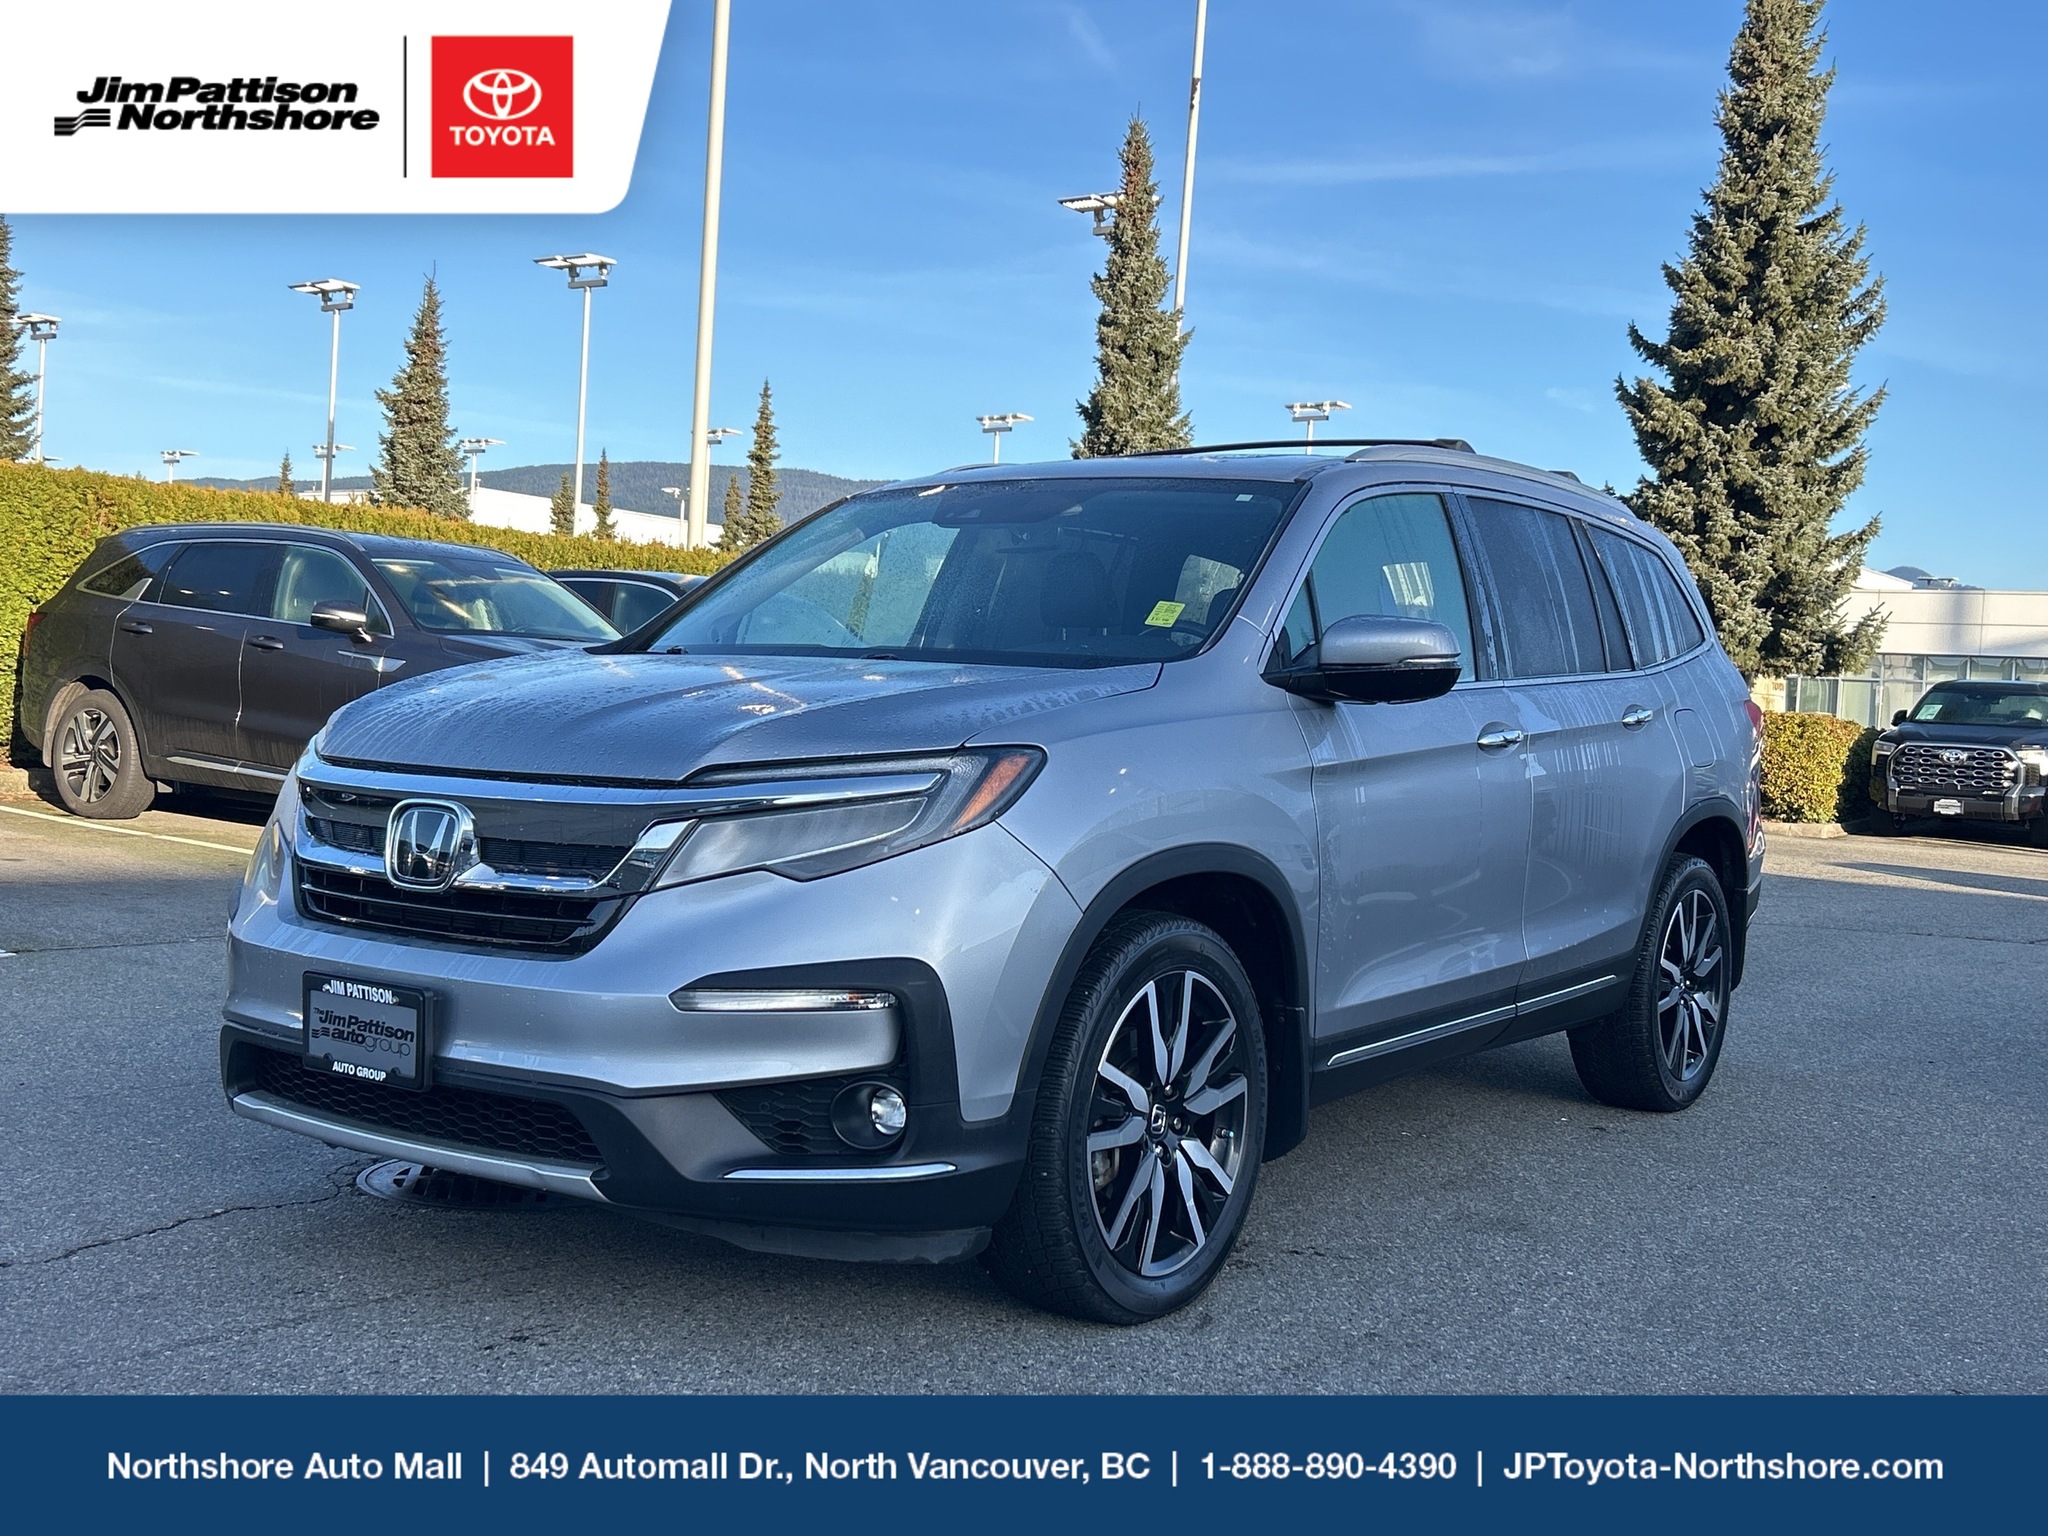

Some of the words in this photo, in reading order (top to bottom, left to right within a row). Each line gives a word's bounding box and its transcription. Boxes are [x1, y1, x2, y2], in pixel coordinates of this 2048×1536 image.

[329, 979, 346, 995] JIM
[346, 982, 395, 1005] PATTISON
[332, 1060, 355, 1075] AUTO
[356, 1066, 387, 1082] GROUP
